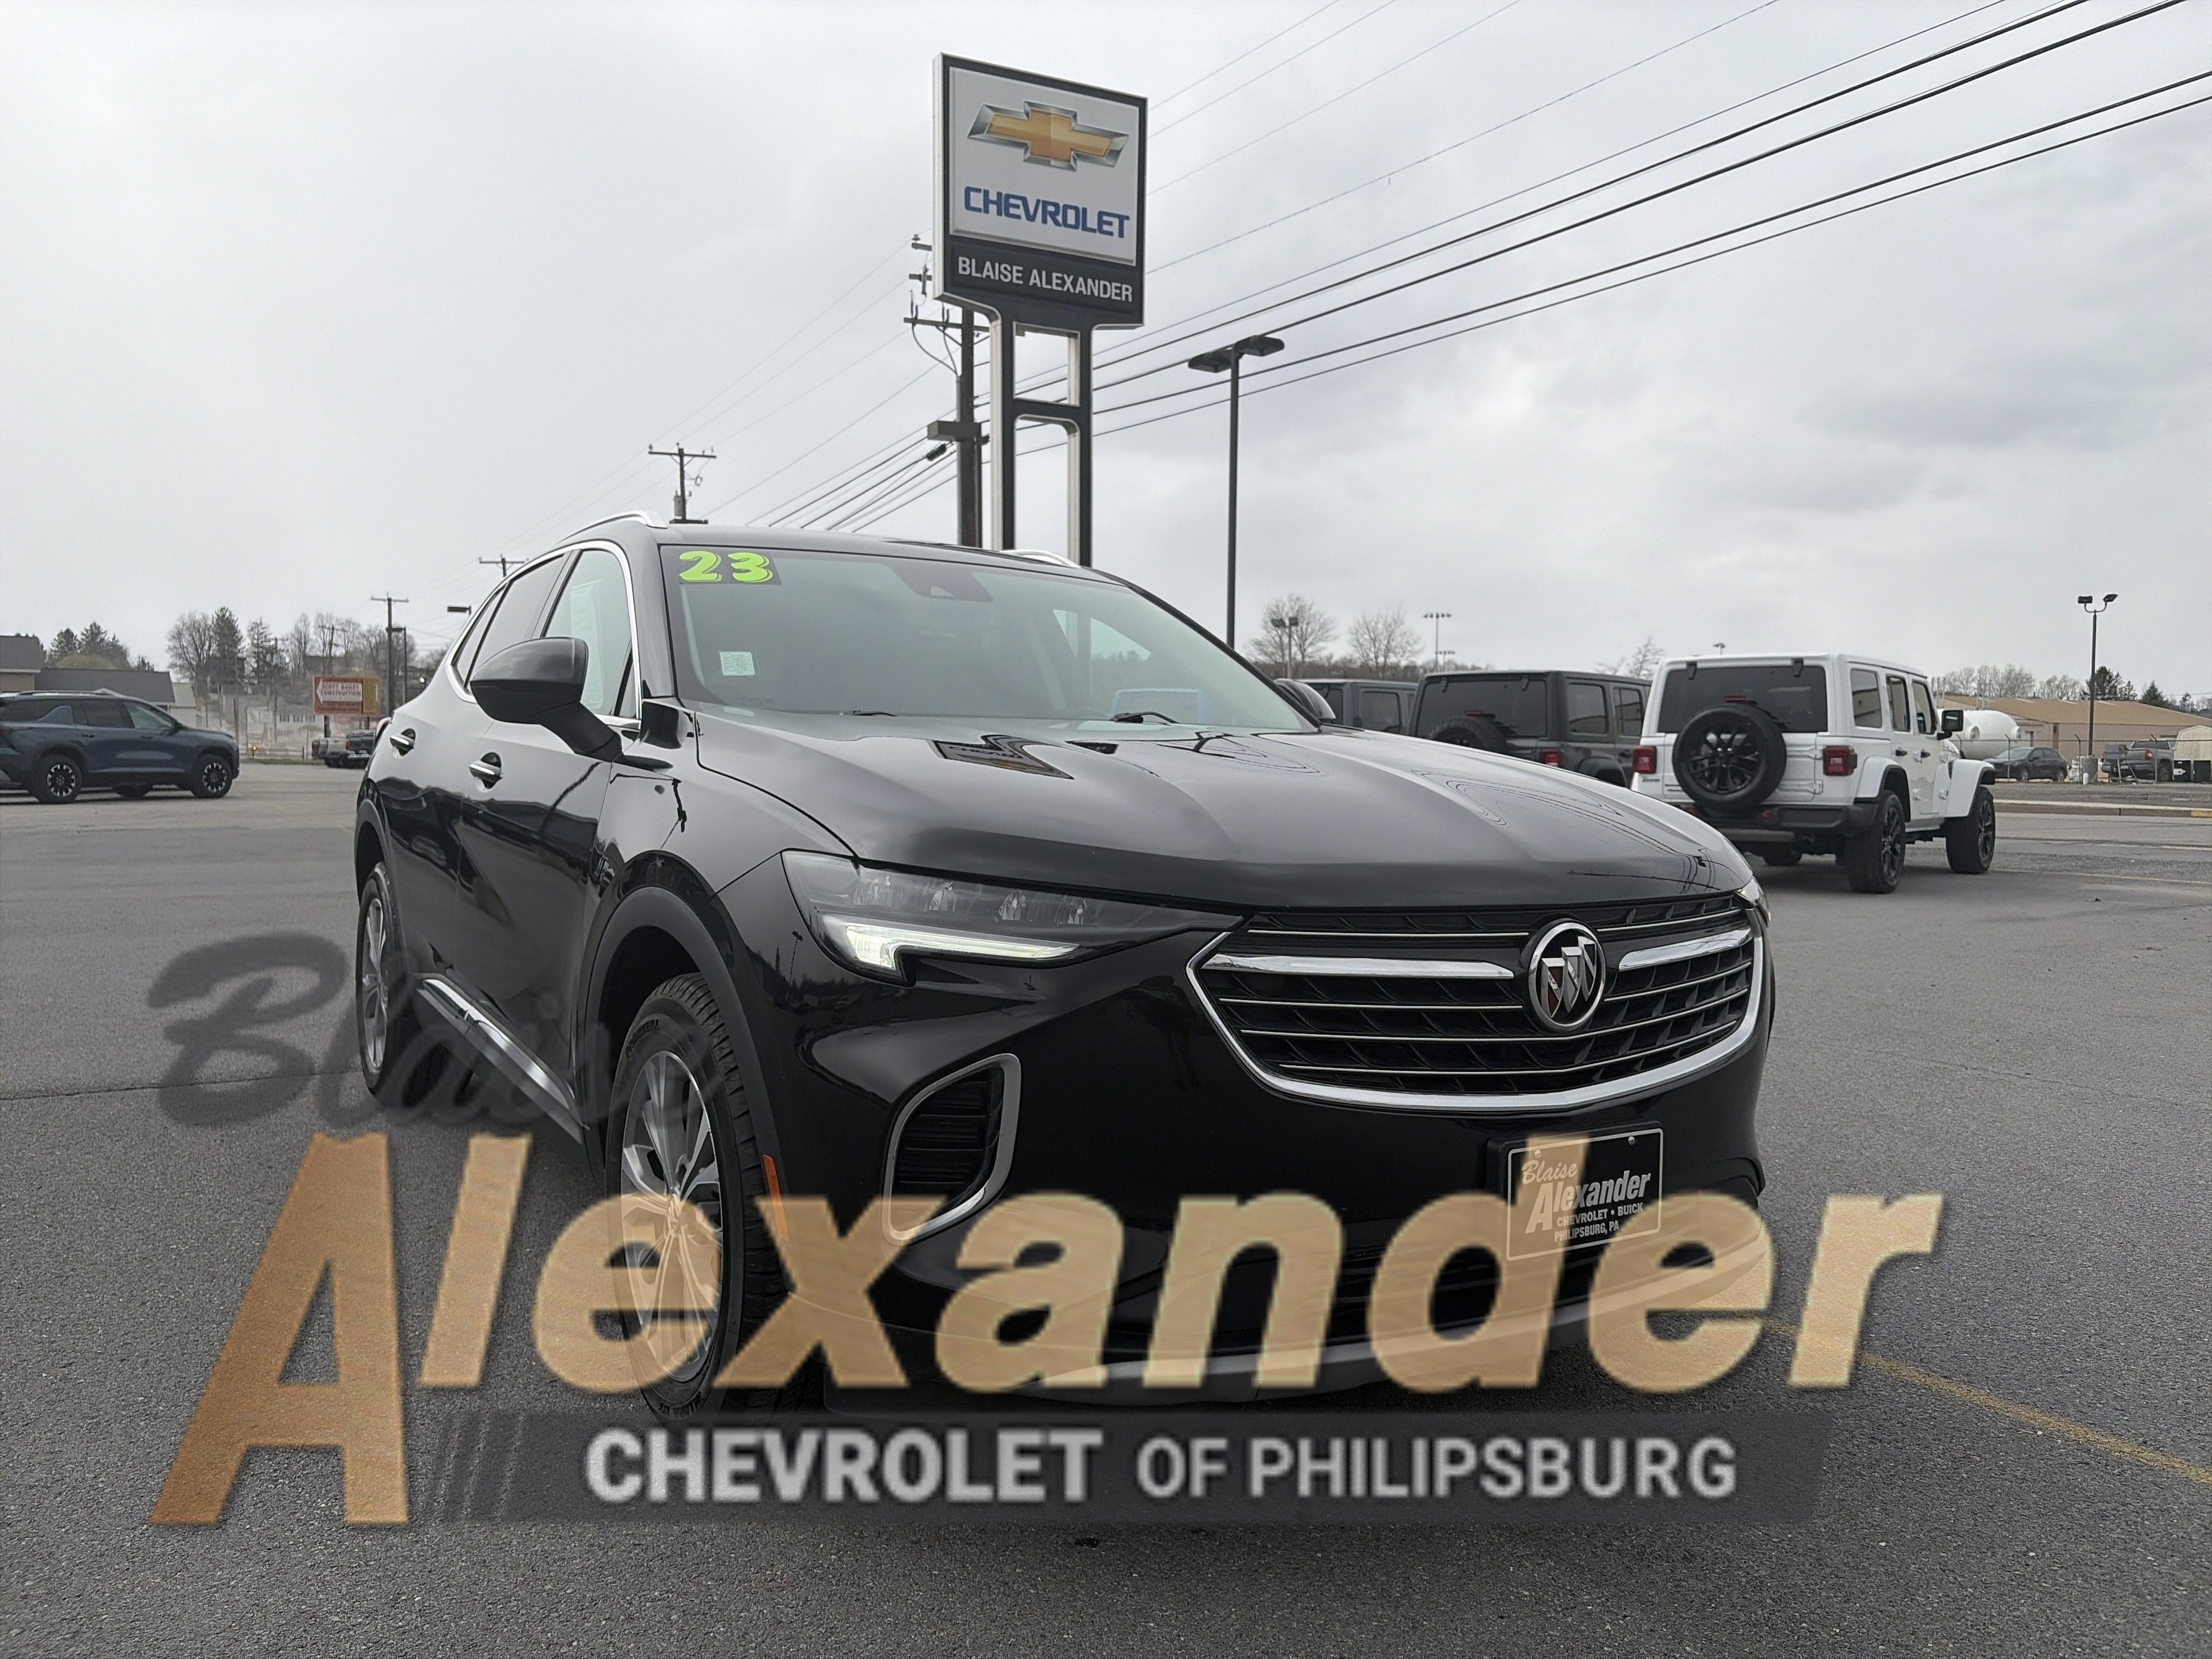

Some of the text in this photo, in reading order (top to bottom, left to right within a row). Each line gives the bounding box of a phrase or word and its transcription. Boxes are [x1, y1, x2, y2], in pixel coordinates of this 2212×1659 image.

[964, 186, 1130, 239] CHEVROLET
[958, 256, 1133, 302] BLAISE ALEXANDER
[679, 550, 773, 583] 23
[1522, 1159, 1577, 1184] Blaise
[1525, 1170, 1651, 1234] Alexander
[1556, 1202, 1645, 1228] CHEVROLET BUICK
[1554, 1220, 1620, 1242] PHILIPSBURG, PA
